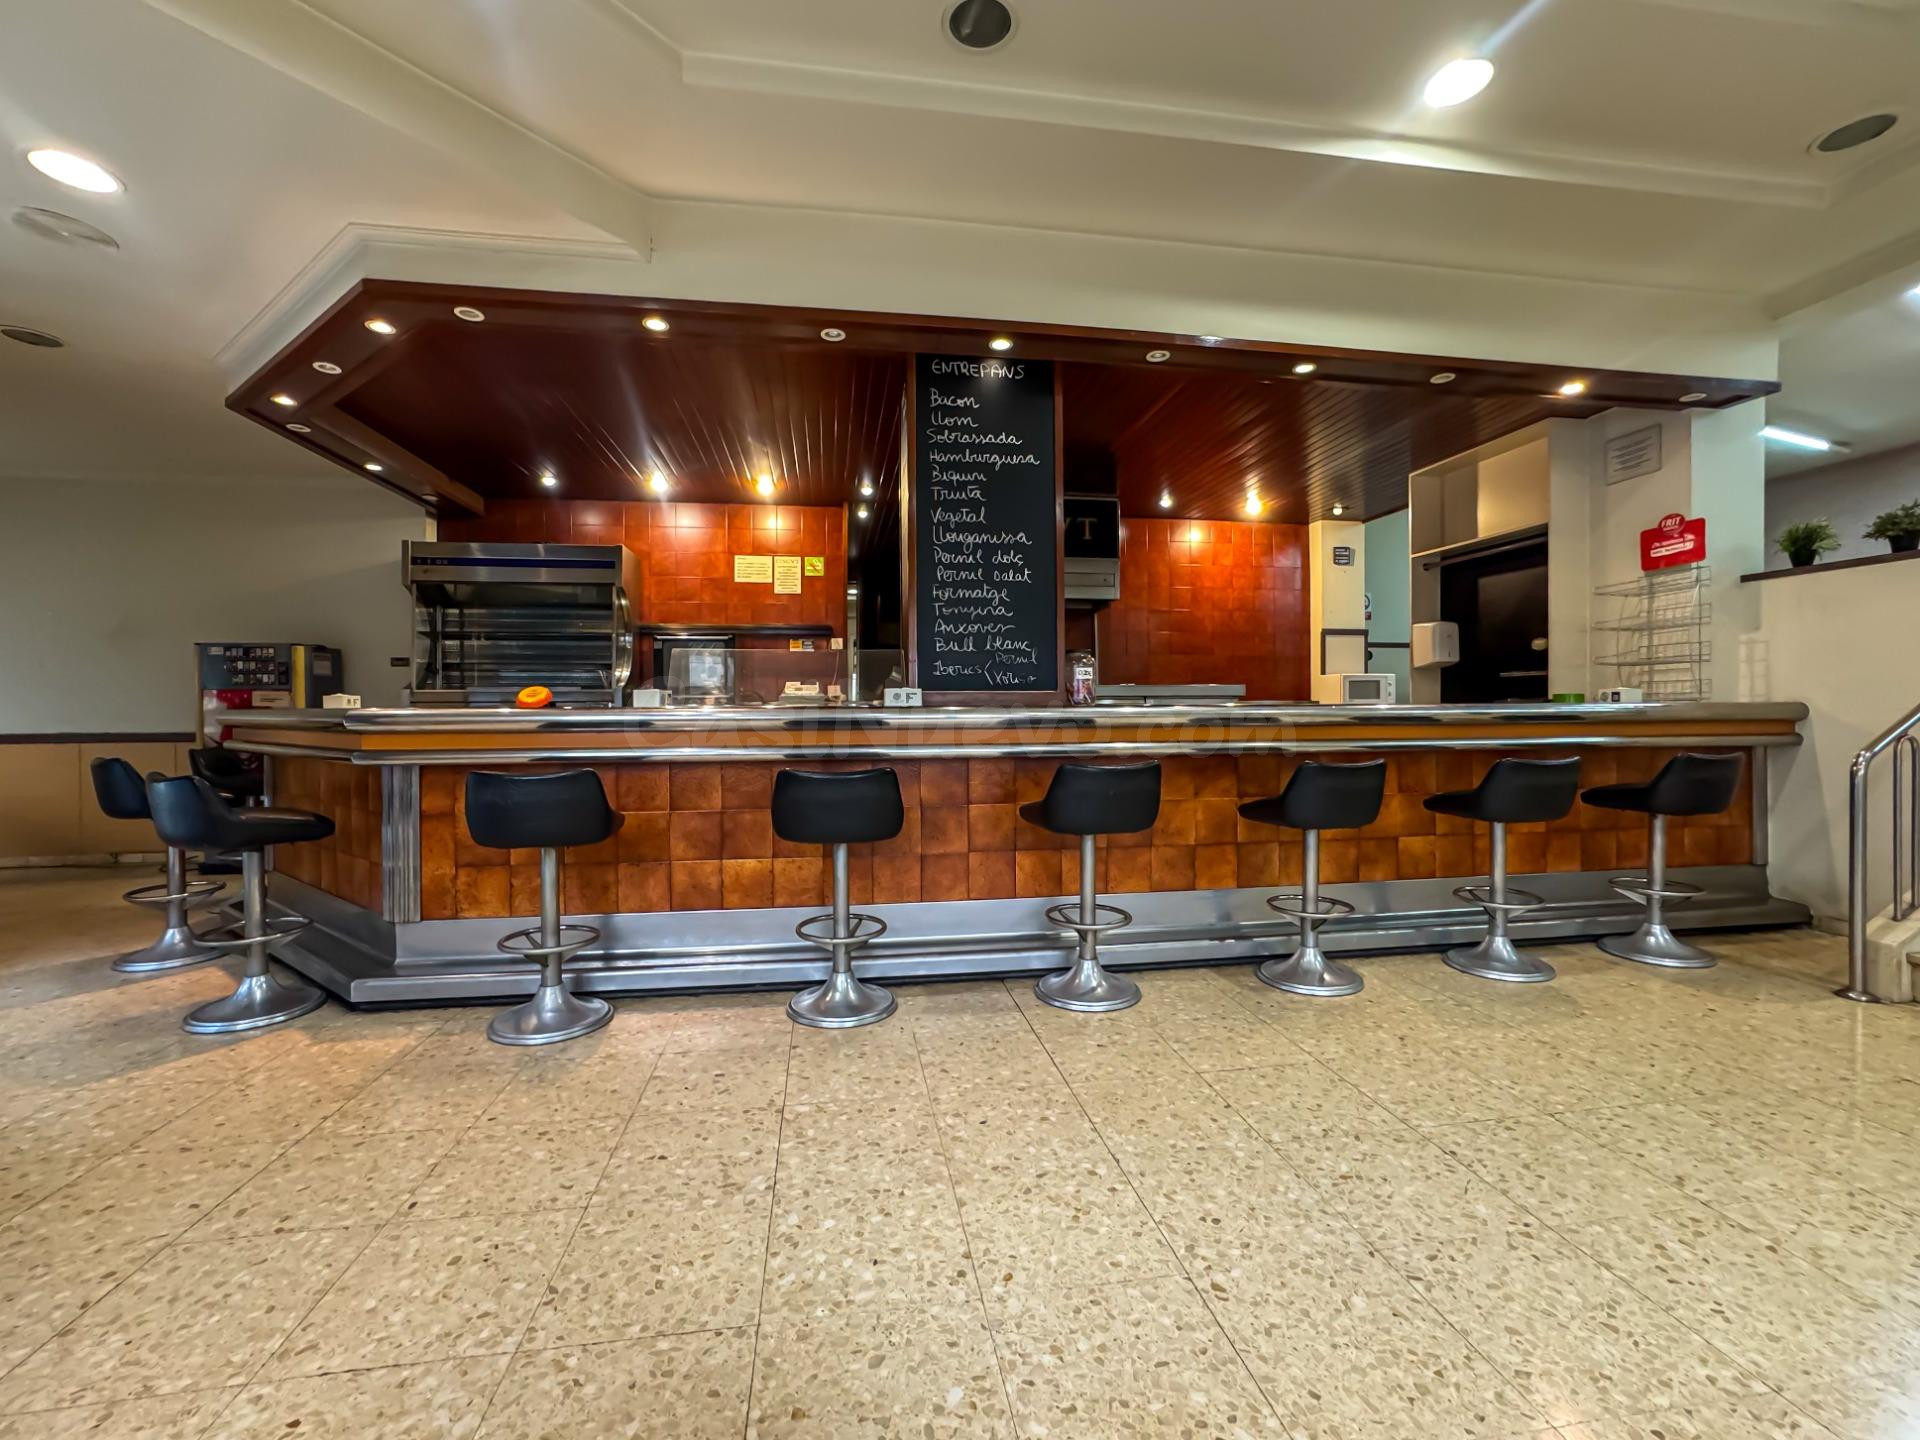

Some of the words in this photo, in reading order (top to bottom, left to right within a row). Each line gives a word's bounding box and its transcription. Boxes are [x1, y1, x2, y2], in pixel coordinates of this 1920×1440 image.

[932, 359, 1025, 379] ENTREPANS
[930, 388, 980, 408] Bacon
[926, 429, 1023, 444] Sobrassada
[929, 449, 1040, 471] Hamburguesa
[931, 506, 987, 528] Vegetal
[1661, 516, 1682, 528] FRIT
[937, 565, 984, 581] Pernil
[933, 583, 1011, 606] Formatge
